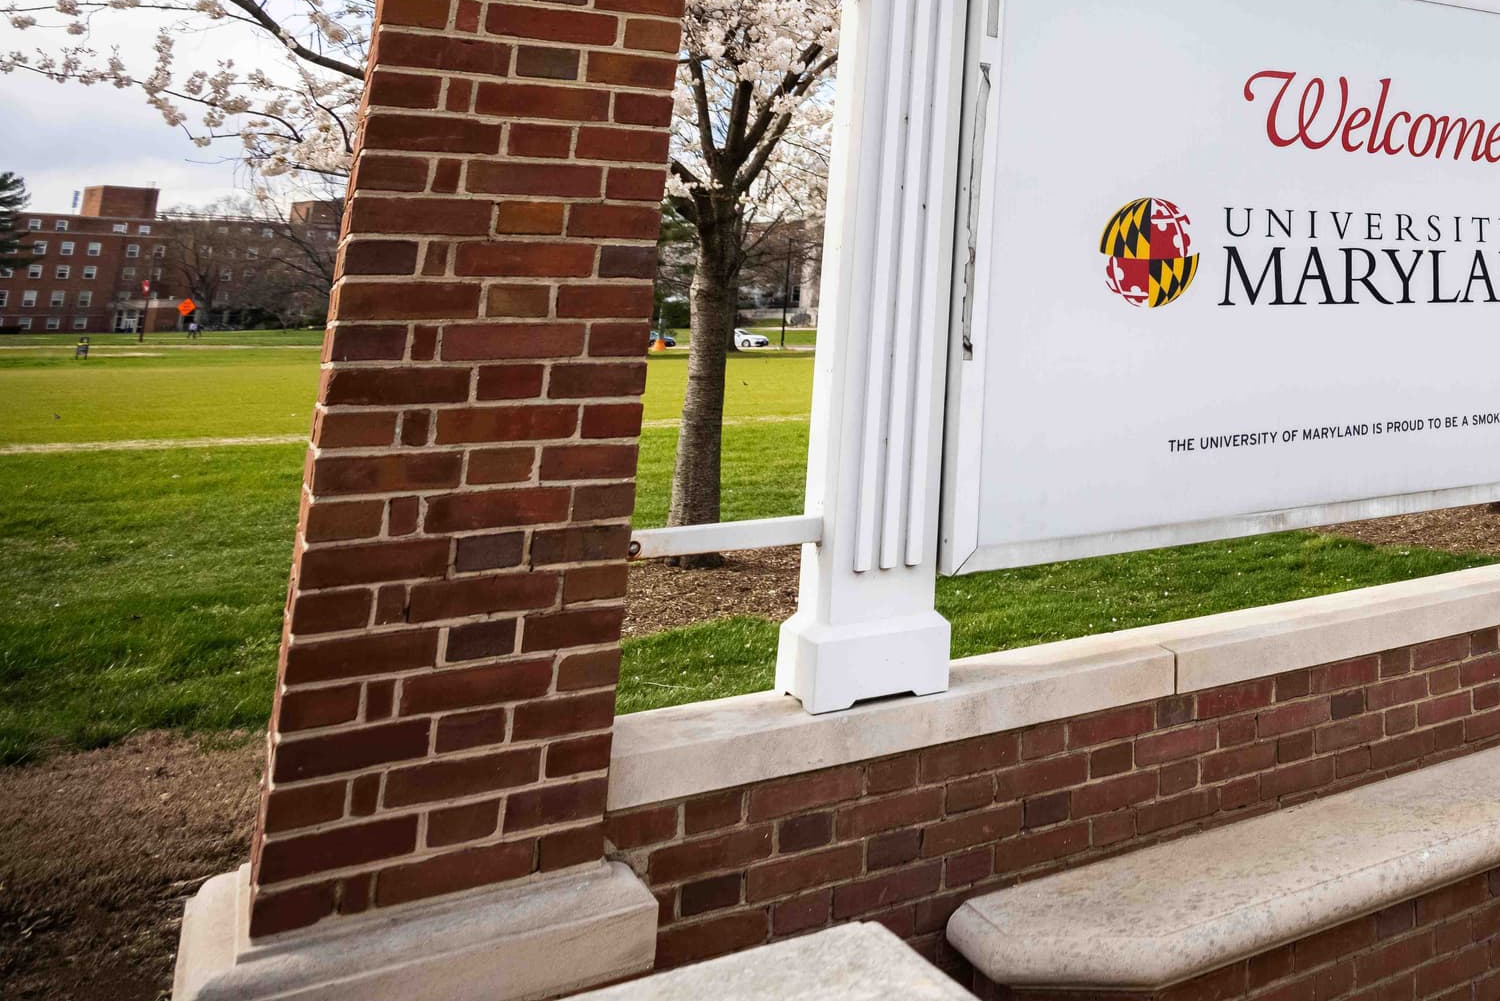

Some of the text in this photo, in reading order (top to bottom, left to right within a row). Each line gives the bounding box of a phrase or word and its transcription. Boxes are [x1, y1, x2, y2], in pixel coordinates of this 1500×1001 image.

[1167, 438, 1195, 453] THE
[1200, 431, 1278, 450] UNIVERSITY
[1281, 429, 1299, 443] OF
[1302, 423, 1369, 441] MARYLAND
[1372, 422, 1383, 435] IS
[1386, 419, 1425, 433] PROUD
[1427, 417, 1442, 430] TO
[1444, 416, 1459, 429] BE
[1461, 415, 1469, 427] A
